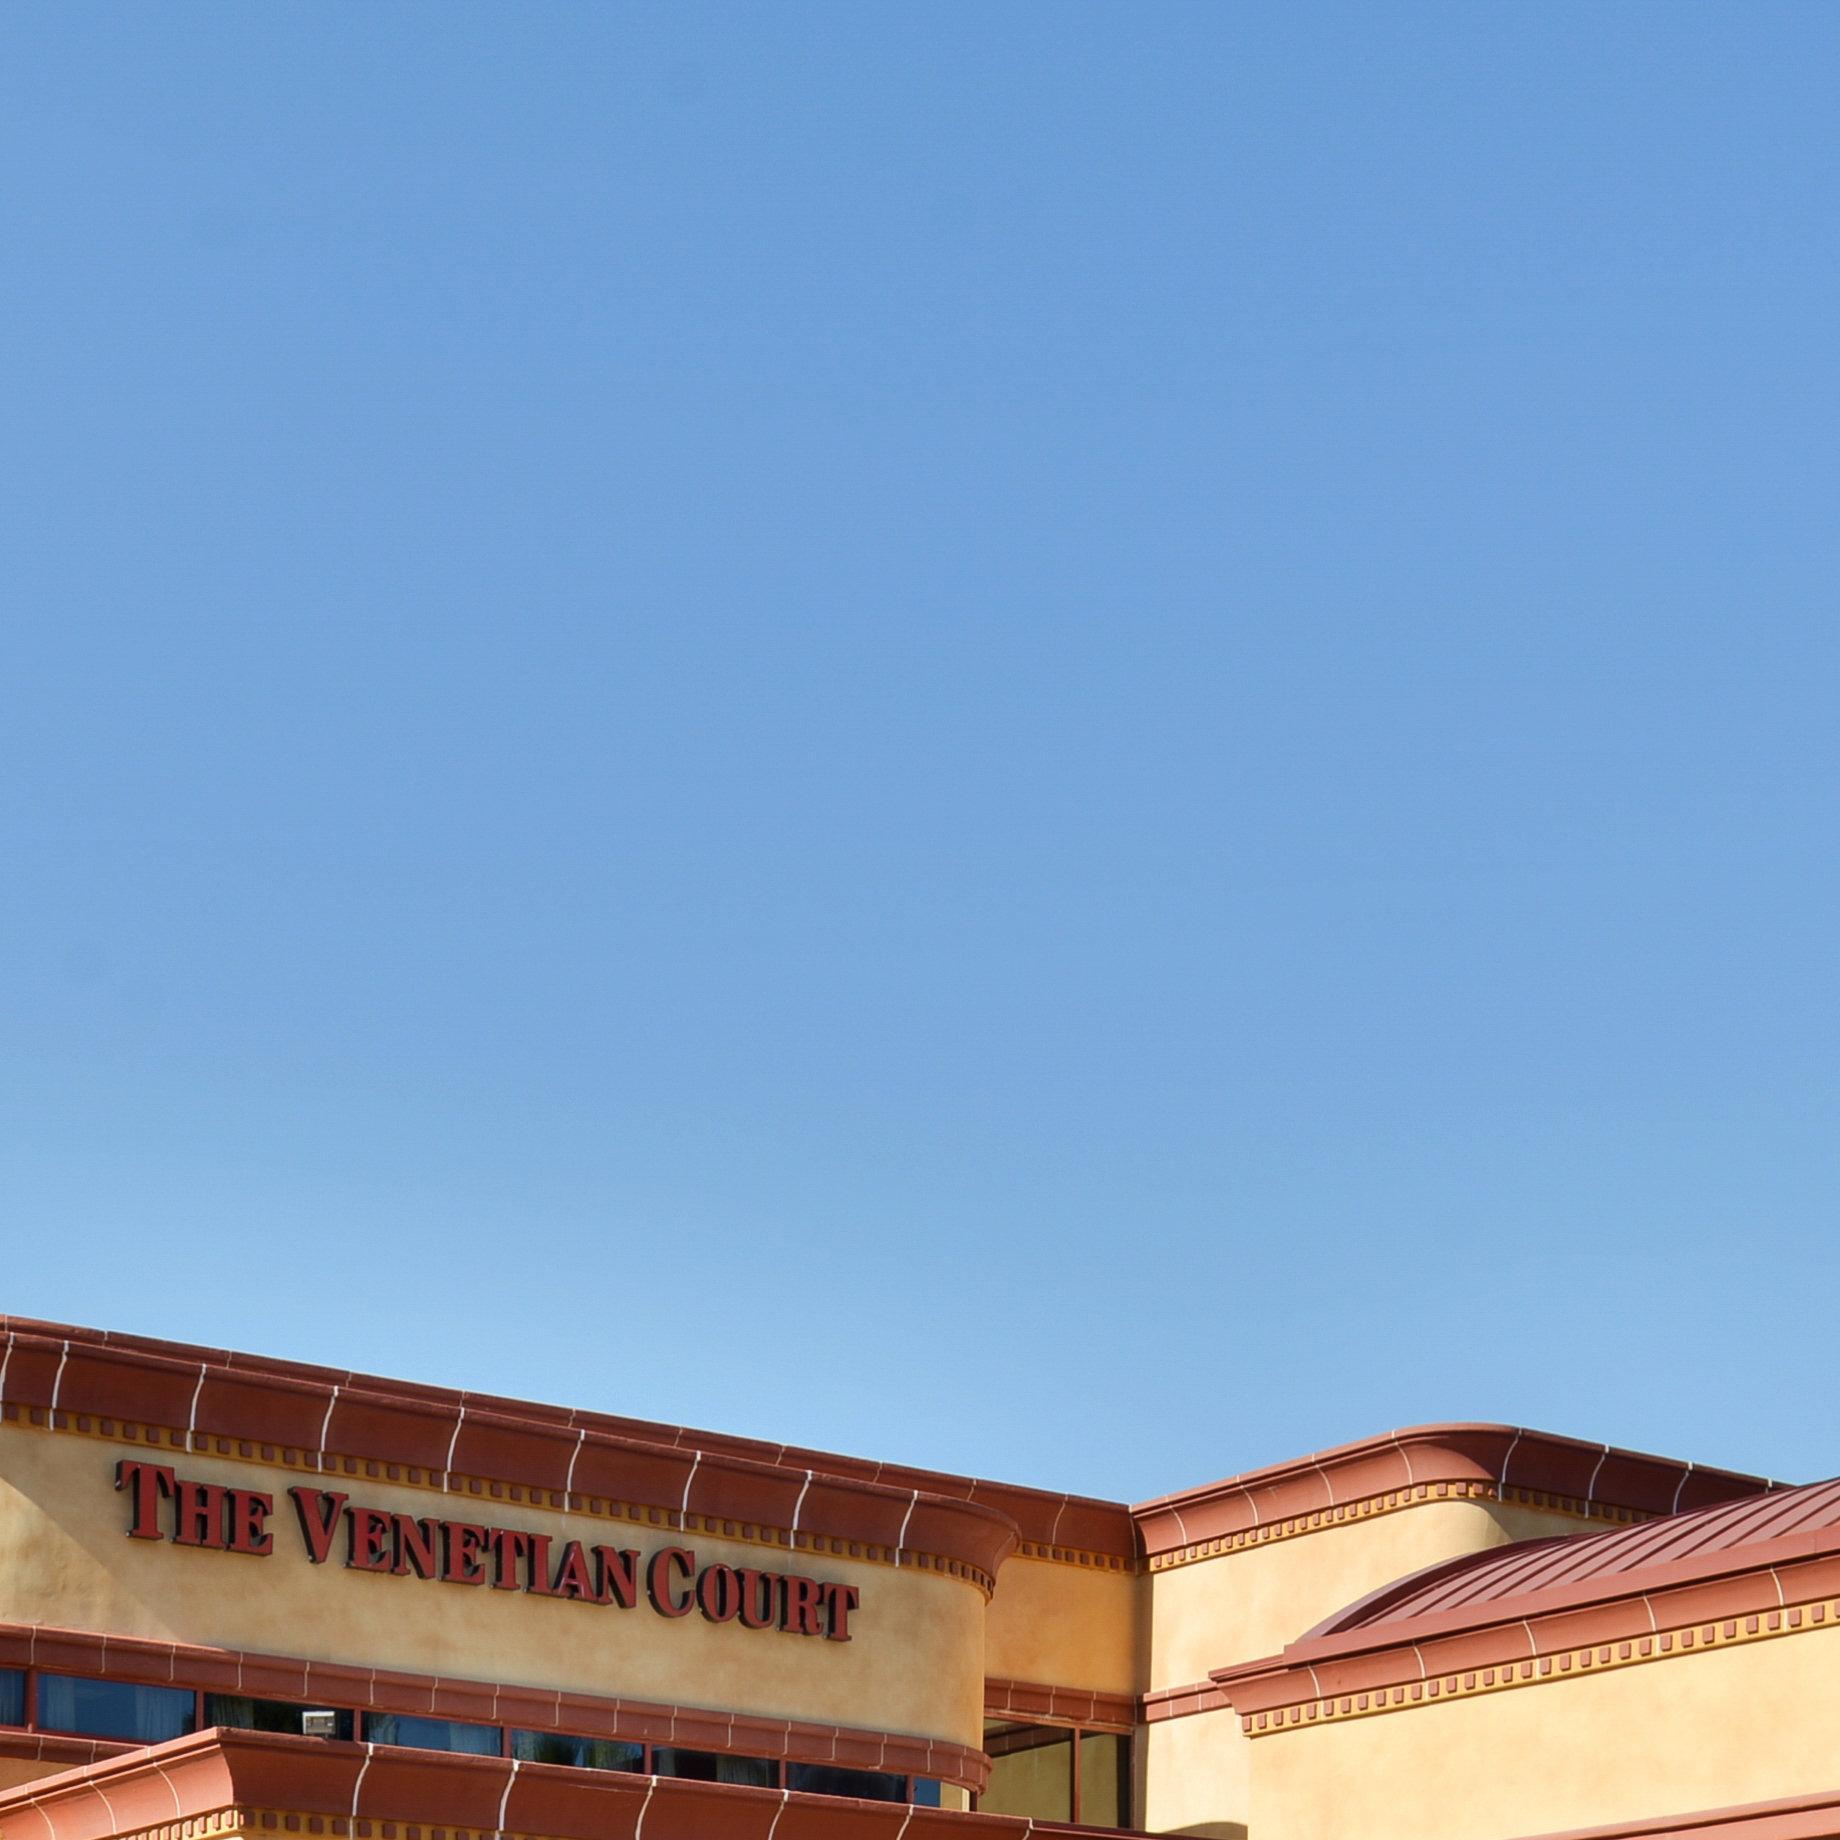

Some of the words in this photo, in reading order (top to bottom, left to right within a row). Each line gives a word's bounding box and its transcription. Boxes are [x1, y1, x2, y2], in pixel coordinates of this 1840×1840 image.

[115, 1459, 274, 1557] THE
[286, 1485, 640, 1609] VENETIAN
[646, 1547, 861, 1643] COURT
